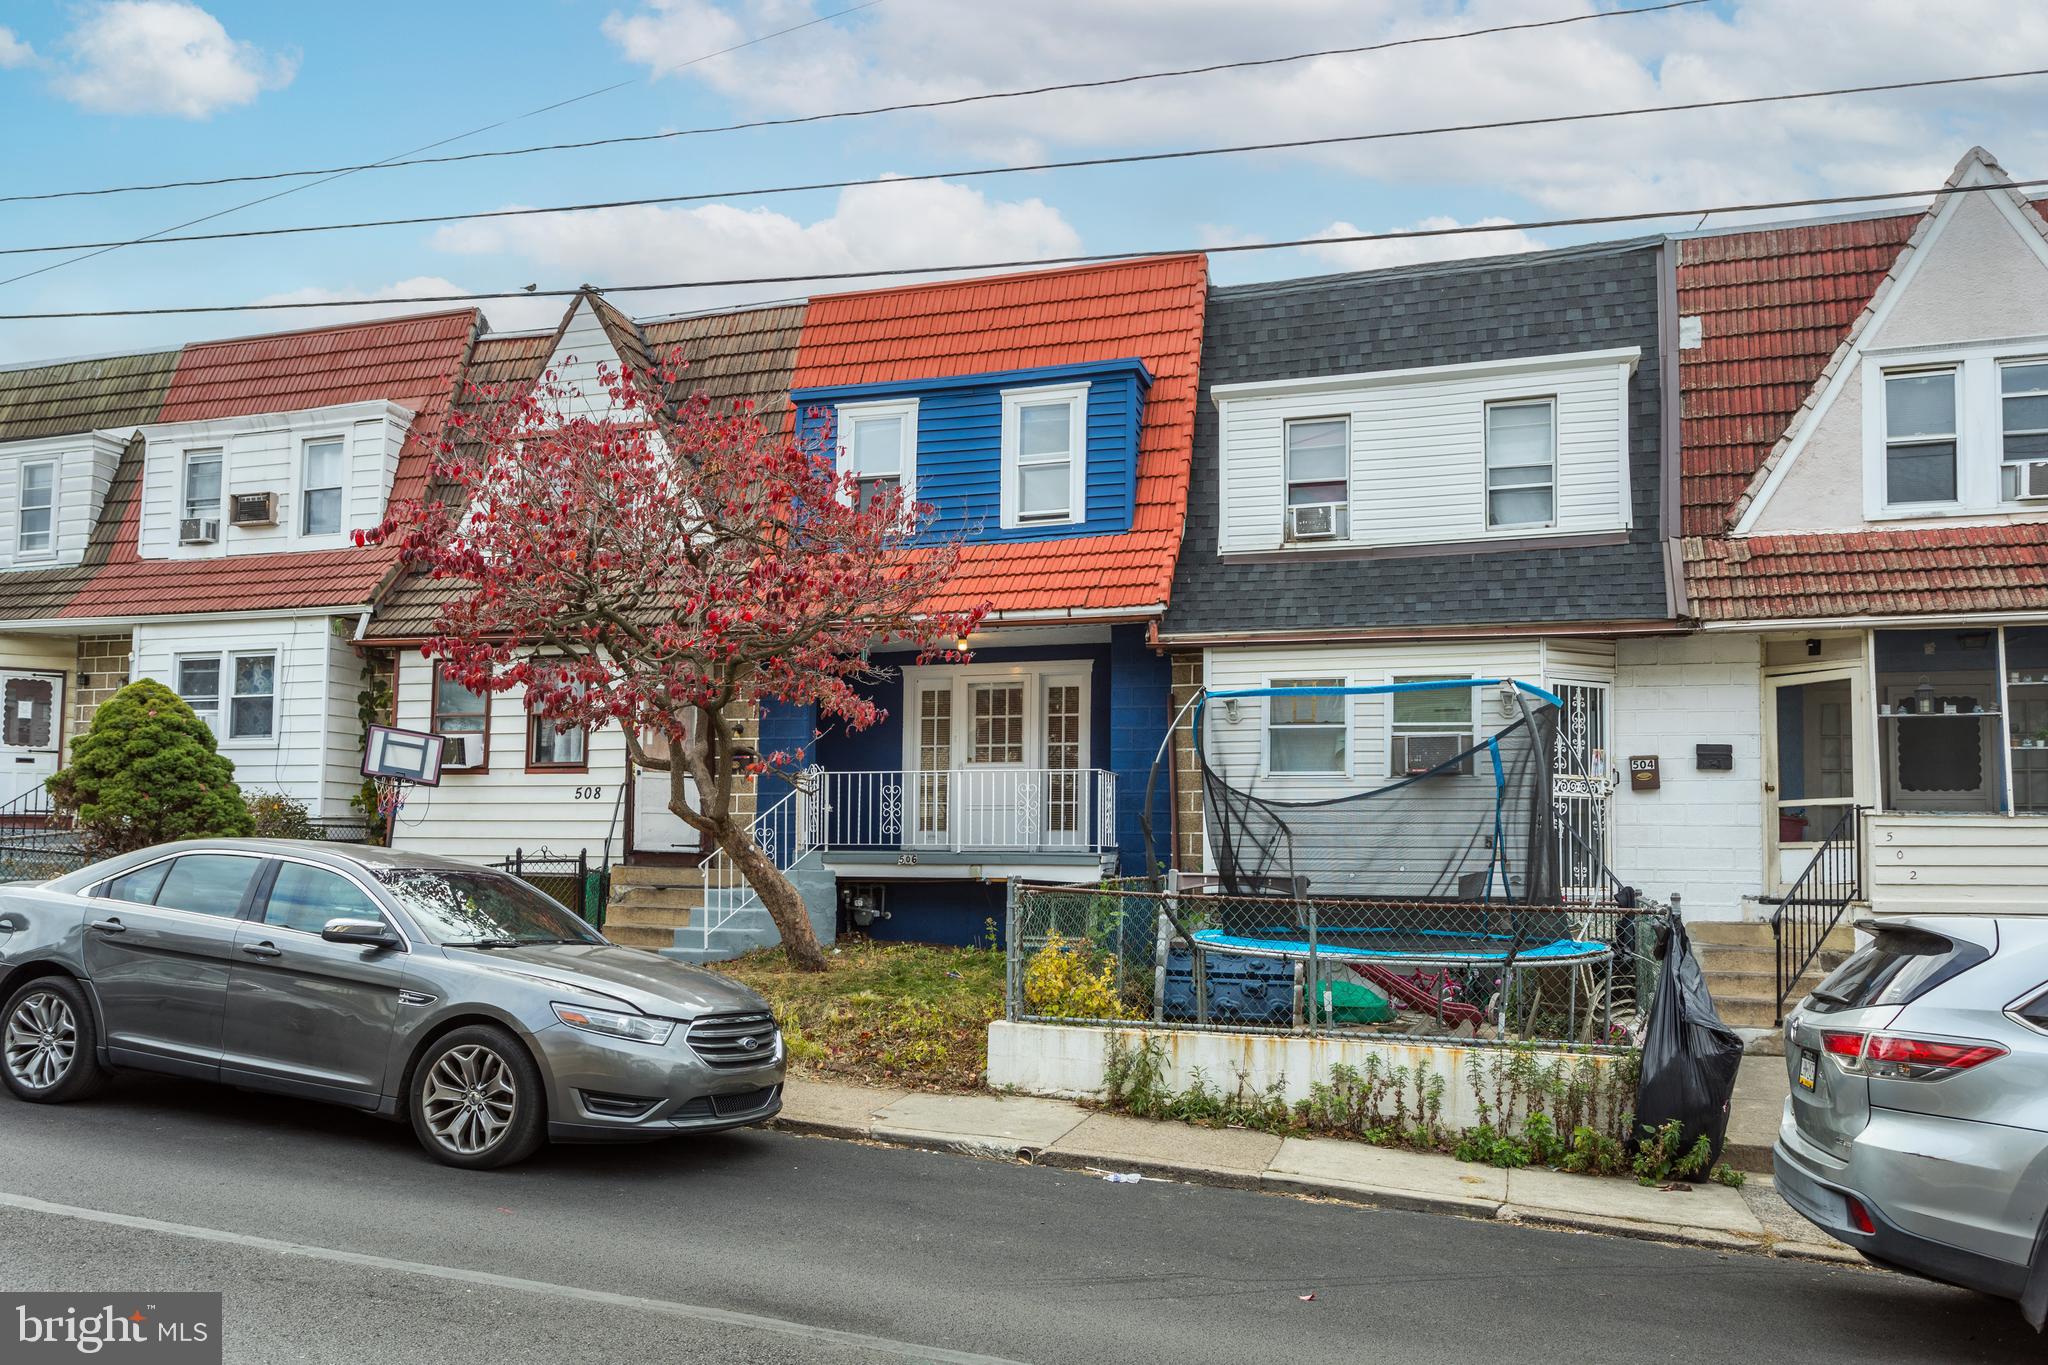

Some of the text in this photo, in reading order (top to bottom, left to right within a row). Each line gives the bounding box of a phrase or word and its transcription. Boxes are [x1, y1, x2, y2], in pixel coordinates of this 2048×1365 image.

[1632, 760, 1654, 769] 504
[575, 786, 602, 799] 508
[899, 855, 917, 864] 506
